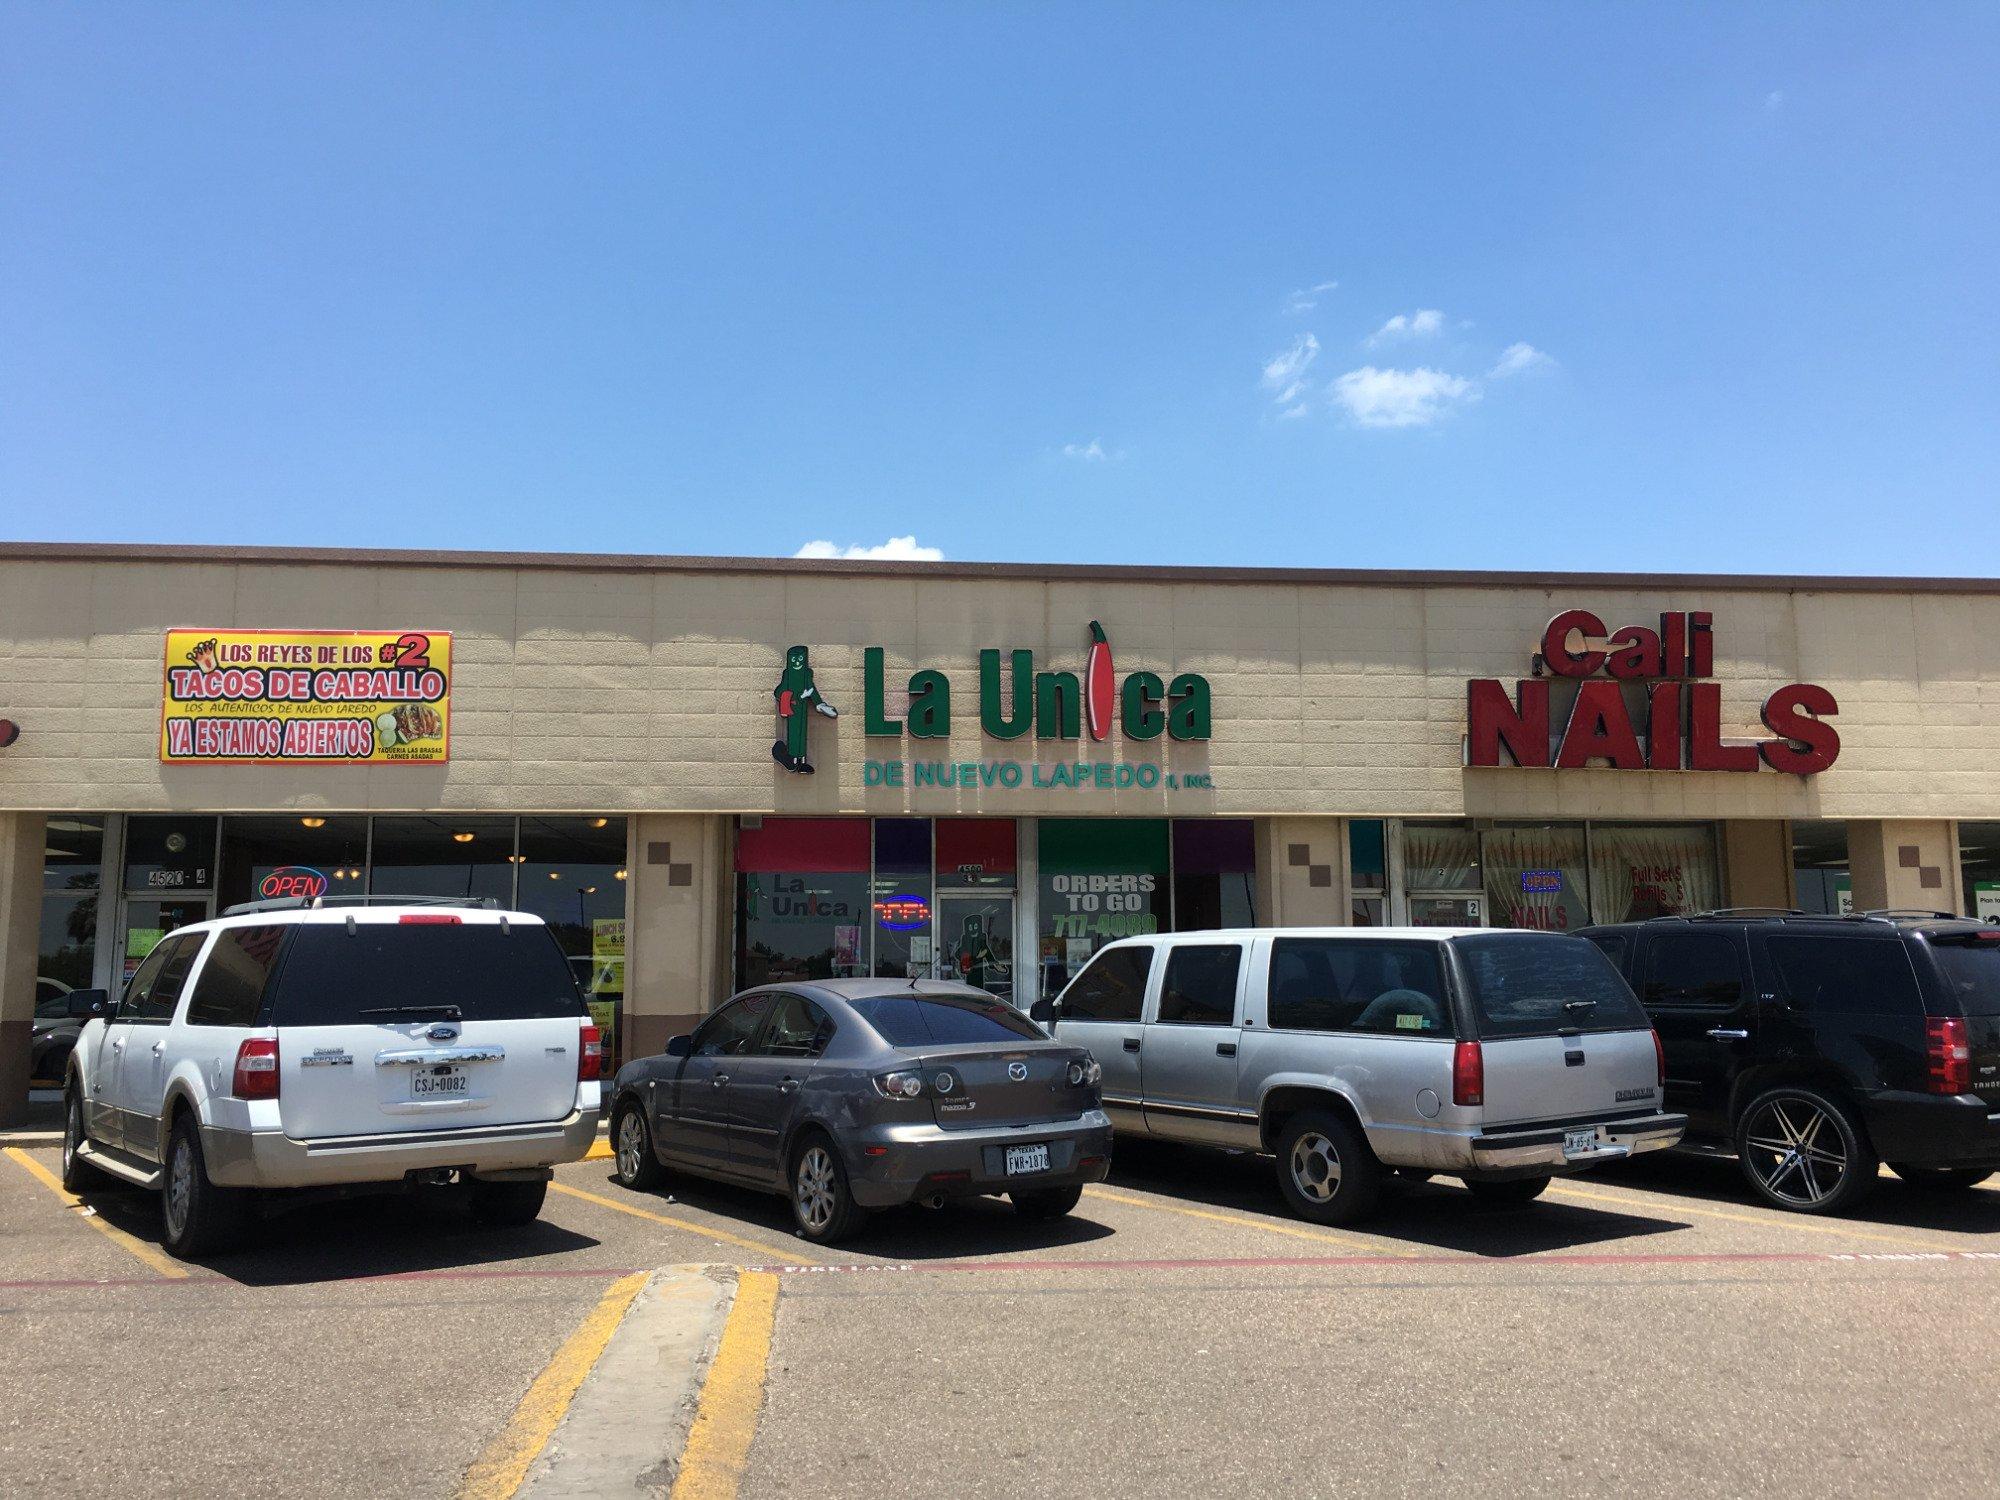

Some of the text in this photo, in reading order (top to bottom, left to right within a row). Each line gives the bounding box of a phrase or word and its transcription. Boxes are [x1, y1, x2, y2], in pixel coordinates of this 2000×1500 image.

[220, 634, 430, 668] LOS REYES DE LOS #2
[1541, 609, 1713, 678] Cali
[171, 669, 443, 700] TACOS DE CABALLO
[864, 620, 1211, 742] La Unica
[184, 703, 377, 714] LOS AUTENTICOS DE NUEVO LAREDO
[169, 719, 373, 756] YA ESTAMOS ABIERTOS
[1468, 680, 1841, 774] NAILS
[864, 762, 904, 787] DE
[914, 762, 1023, 788] NUEVO
[262, 876, 322, 897] OPEN
[774, 874, 805, 892] La
[1052, 874, 1156, 893] ORDERS
[1066, 893, 1142, 911] TO GO
[1470, 902, 1477, 914] 2
[1511, 906, 1567, 929] NAILS
